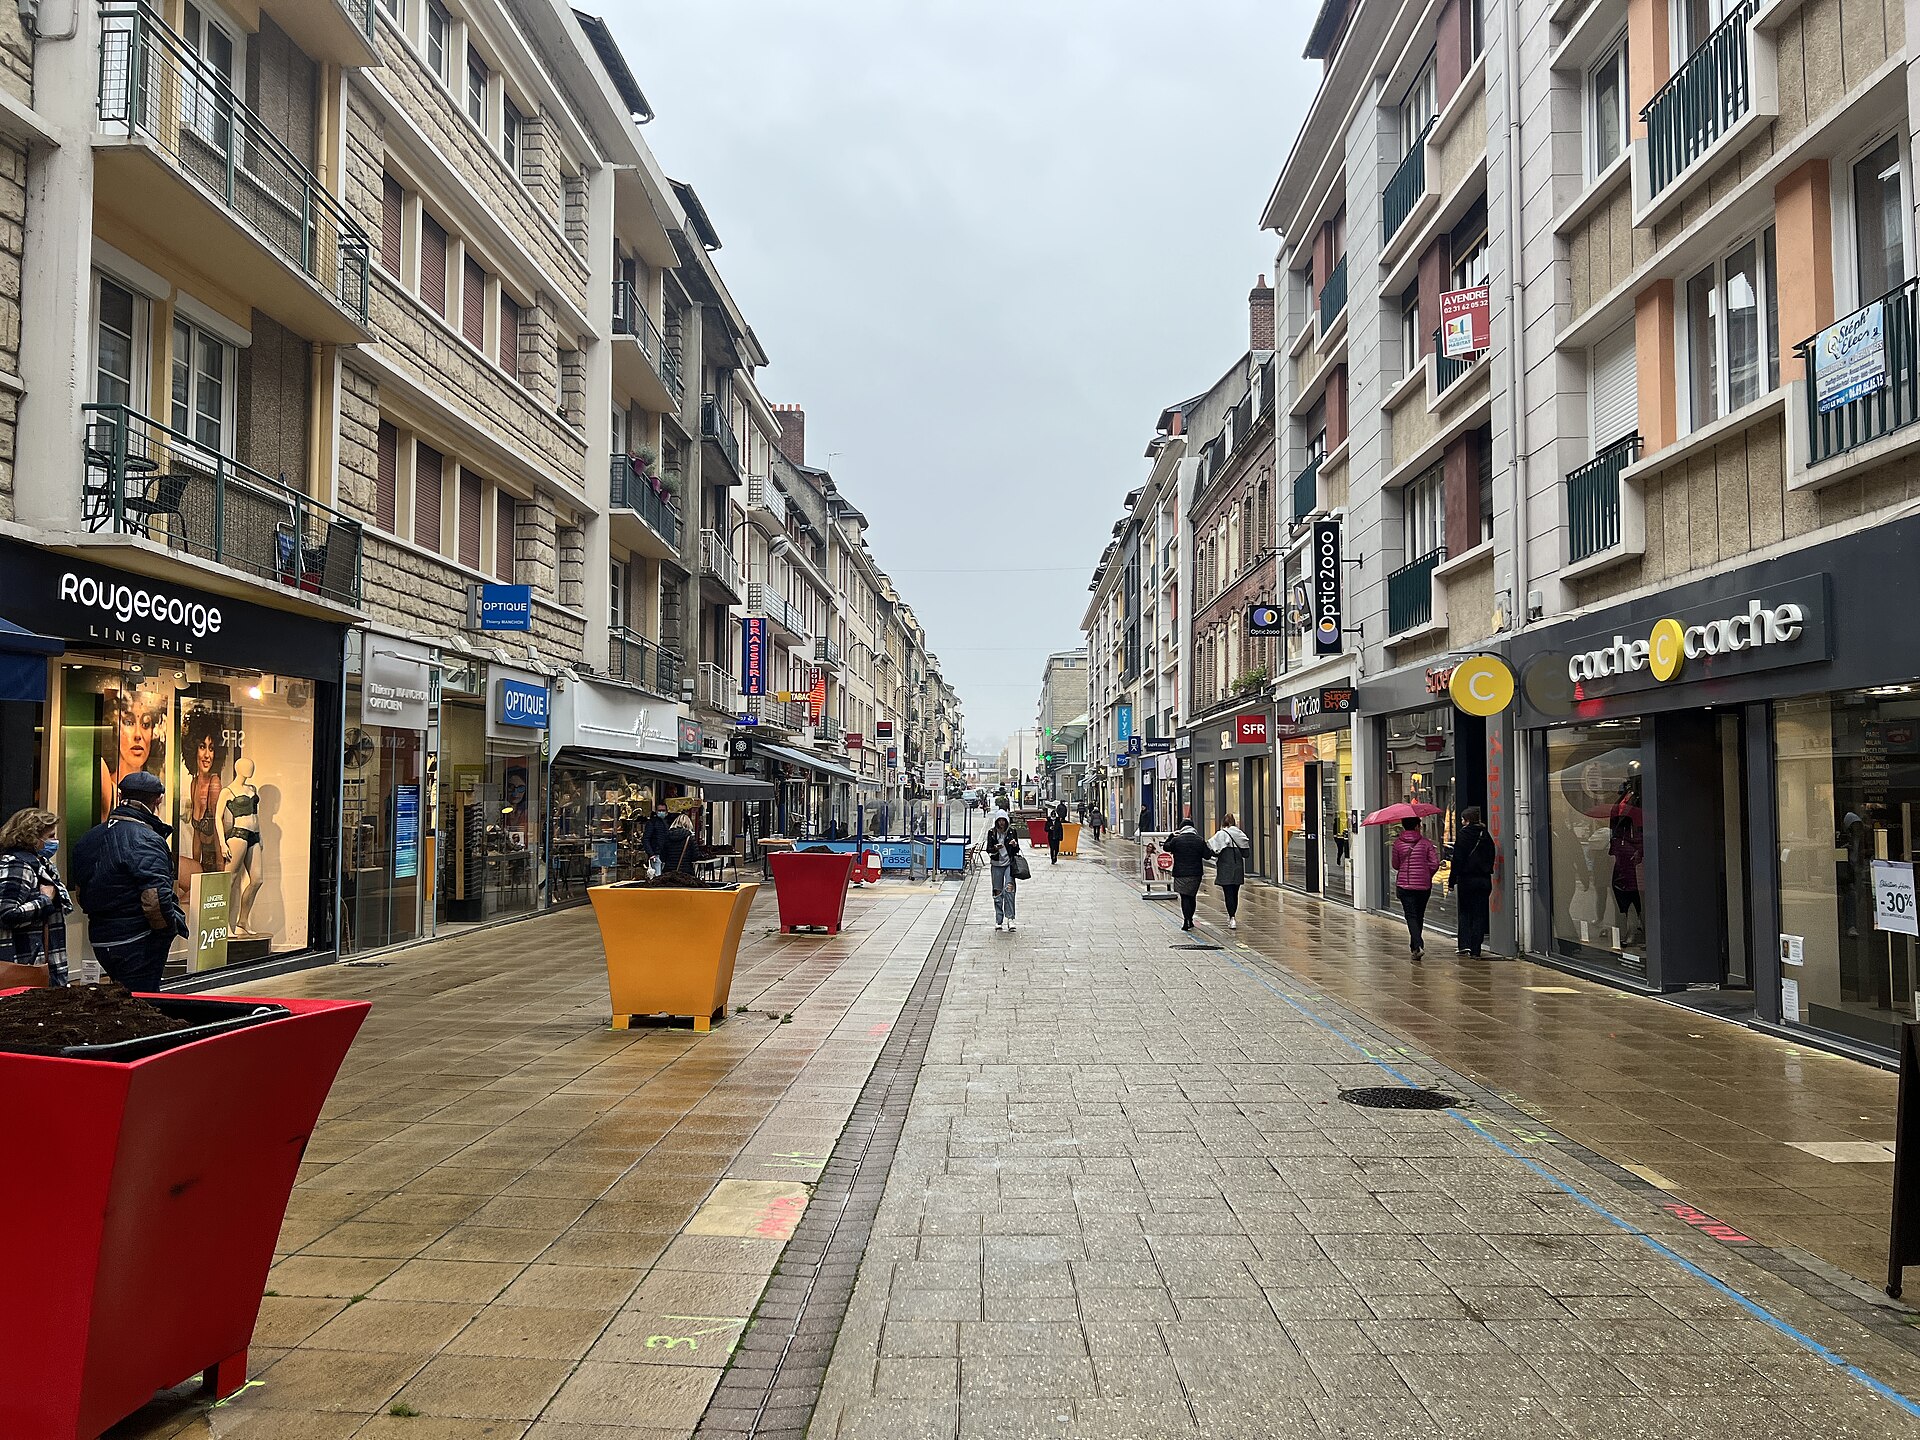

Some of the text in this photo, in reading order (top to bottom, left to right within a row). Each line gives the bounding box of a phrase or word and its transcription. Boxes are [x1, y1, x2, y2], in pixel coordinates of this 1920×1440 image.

[1451, 289, 1488, 304] VENDRE
[1443, 306, 1453, 314] 02
[1318, 530, 1341, 633] Optic 2000
[483, 602, 527, 612] OPTIQUE
[89, 624, 193, 654] LINGERIE
[1568, 635, 1650, 683] cache
[1683, 599, 1803, 660] cache
[749, 619, 761, 694] BRASSERIE
[370, 682, 396, 698] Thierry
[1424, 667, 1452, 697] Super
[1468, 671, 1496, 701] C
[369, 697, 403, 711] OPTICIEN
[505, 689, 544, 716] OPTIQUE
[790, 692, 811, 701] TABAC
[1323, 692, 1352, 701] Super
[1242, 723, 1265, 735] SFR
[1880, 891, 1913, 914] -30%
